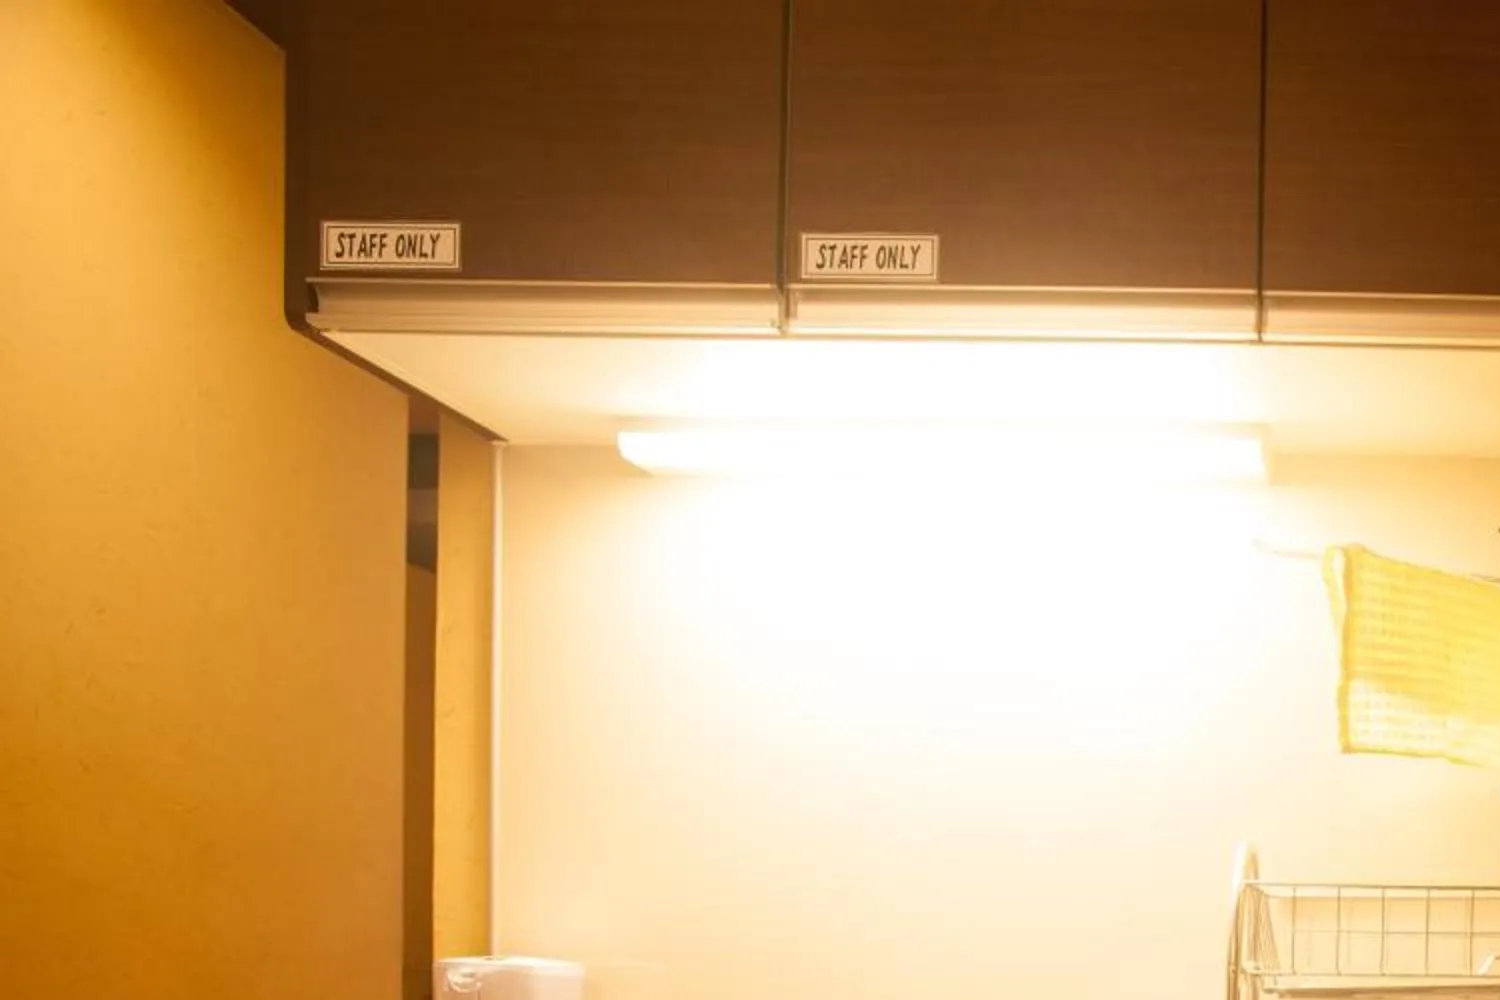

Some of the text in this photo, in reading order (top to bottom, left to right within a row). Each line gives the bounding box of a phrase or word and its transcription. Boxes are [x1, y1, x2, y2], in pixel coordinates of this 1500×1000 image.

[335, 230, 442, 260] STAFF ONLY
[815, 243, 921, 270] STAFF ONLY
